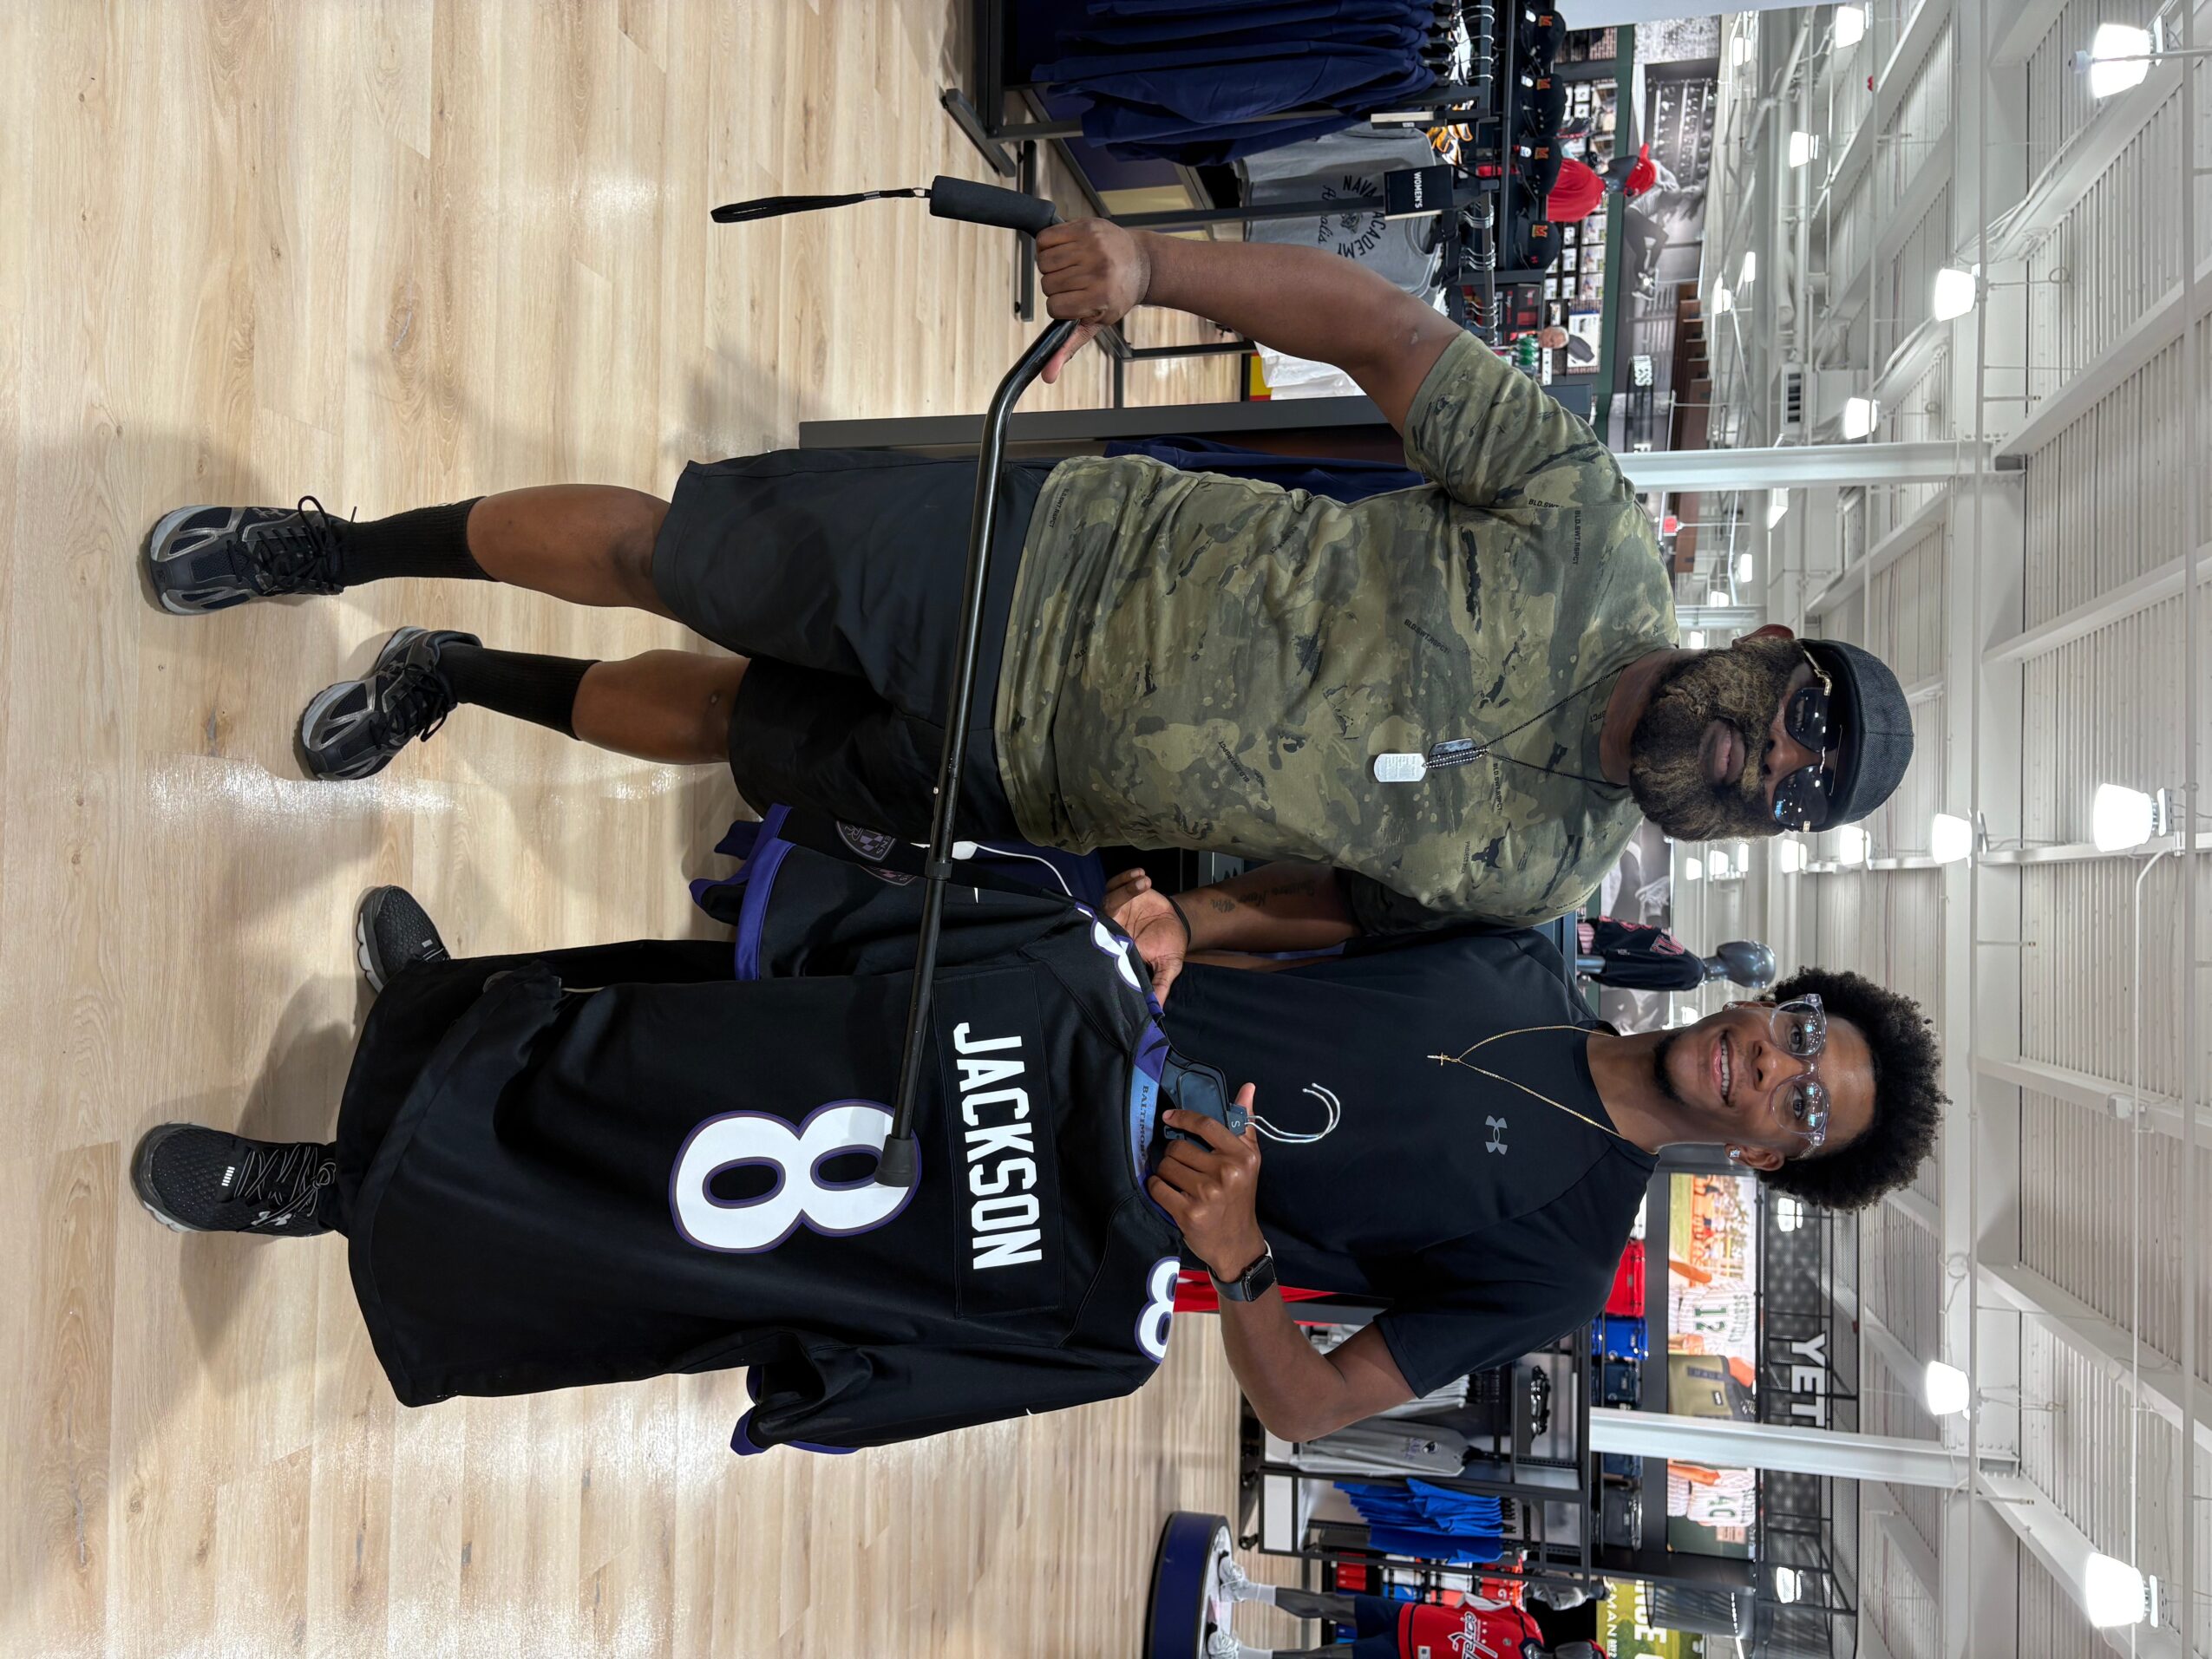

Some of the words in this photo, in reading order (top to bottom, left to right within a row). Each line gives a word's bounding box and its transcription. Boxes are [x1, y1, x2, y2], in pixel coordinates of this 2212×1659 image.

[1343, 175, 1378, 198] NAVA
[1413, 172, 1423, 208] WOMEN'S
[668, 1099, 922, 1254] 8
[952, 1022, 1043, 1270] JACKSON
[1694, 1305, 1727, 1334] 12
[1790, 1333, 1825, 1429] YET
